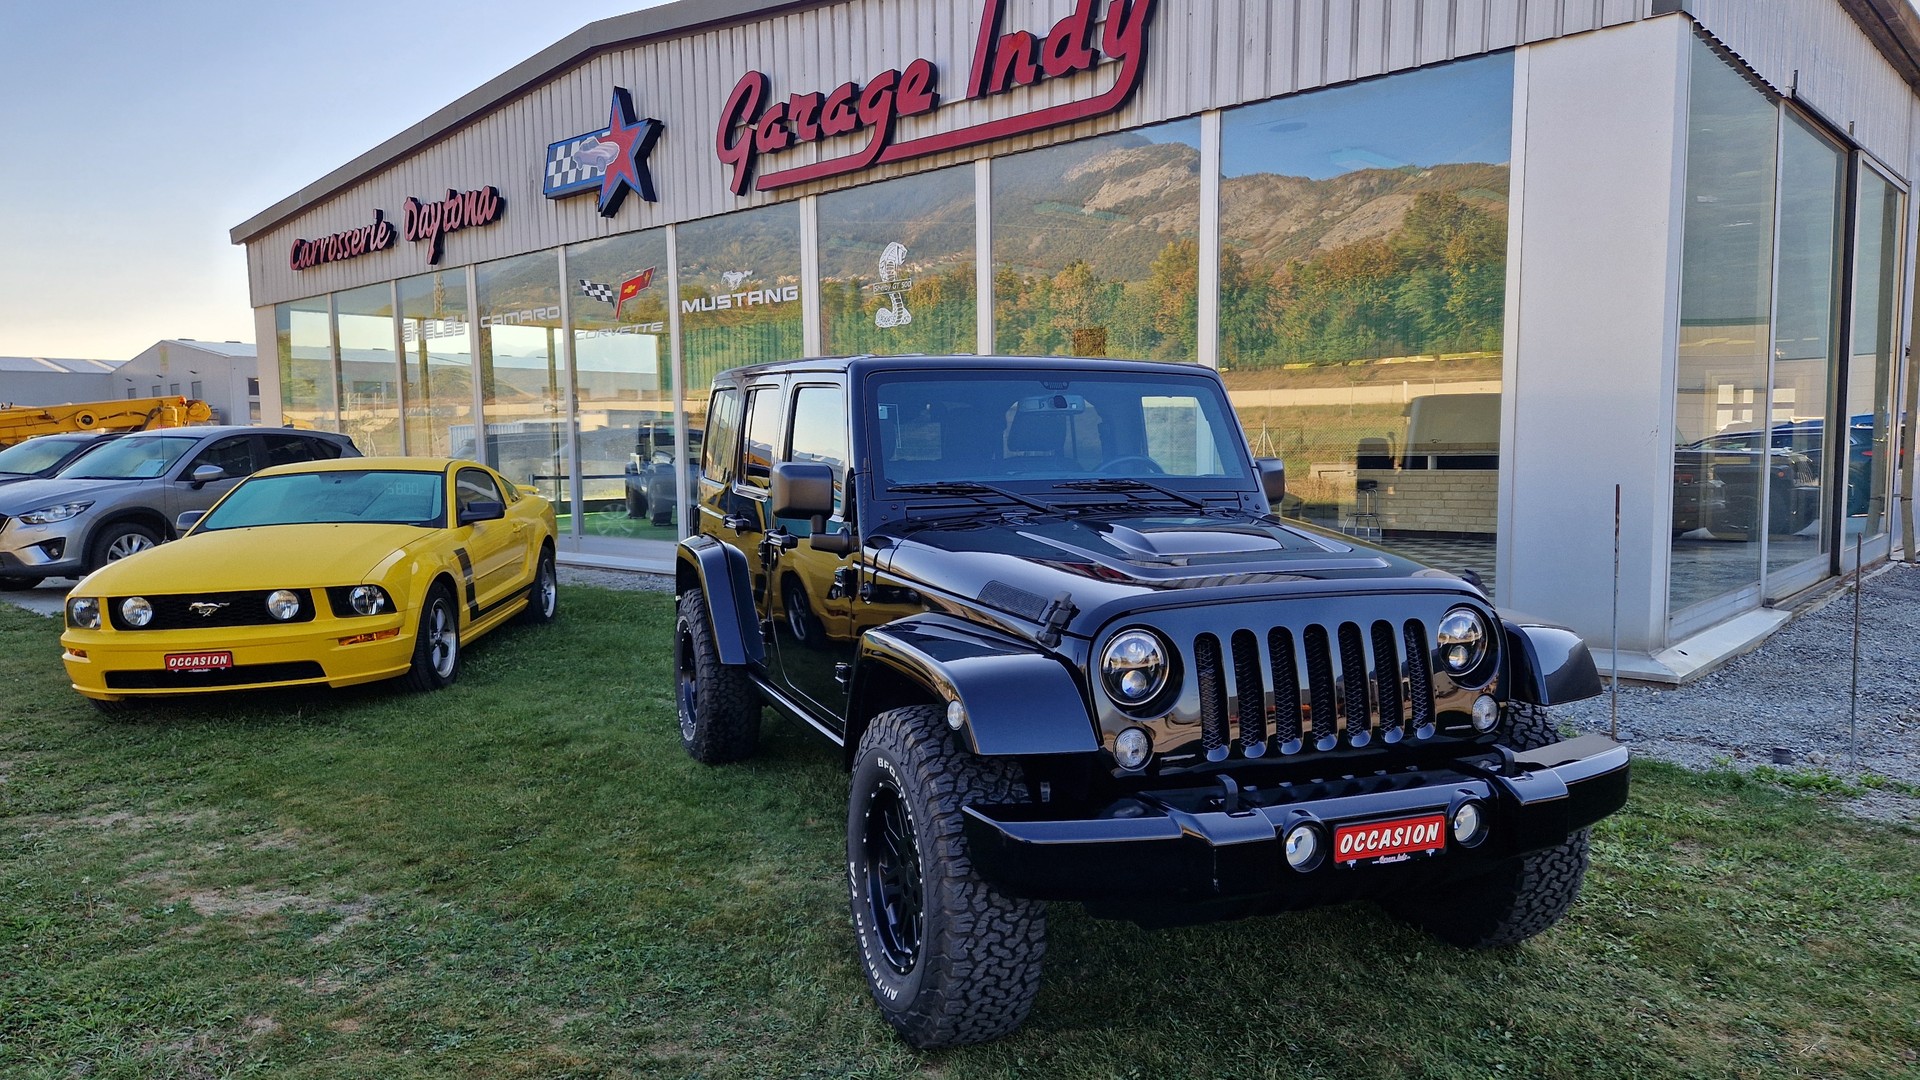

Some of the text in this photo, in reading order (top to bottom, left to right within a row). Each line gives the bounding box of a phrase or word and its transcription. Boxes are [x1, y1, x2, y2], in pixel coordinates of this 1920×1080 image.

[716, 58, 940, 196] Garage
[290, 185, 504, 271] Carrosserie Daytona
[681, 285, 799, 314] MUSTANG
[402, 314, 466, 343] SHELBY
[480, 306, 561, 329] CAMARO
[575, 321, 664, 341] CORVETTE
[169, 655, 228, 667] OCCASION
[1340, 822, 1440, 854] OCCASION
[856, 913, 898, 1001] All-Terrain
